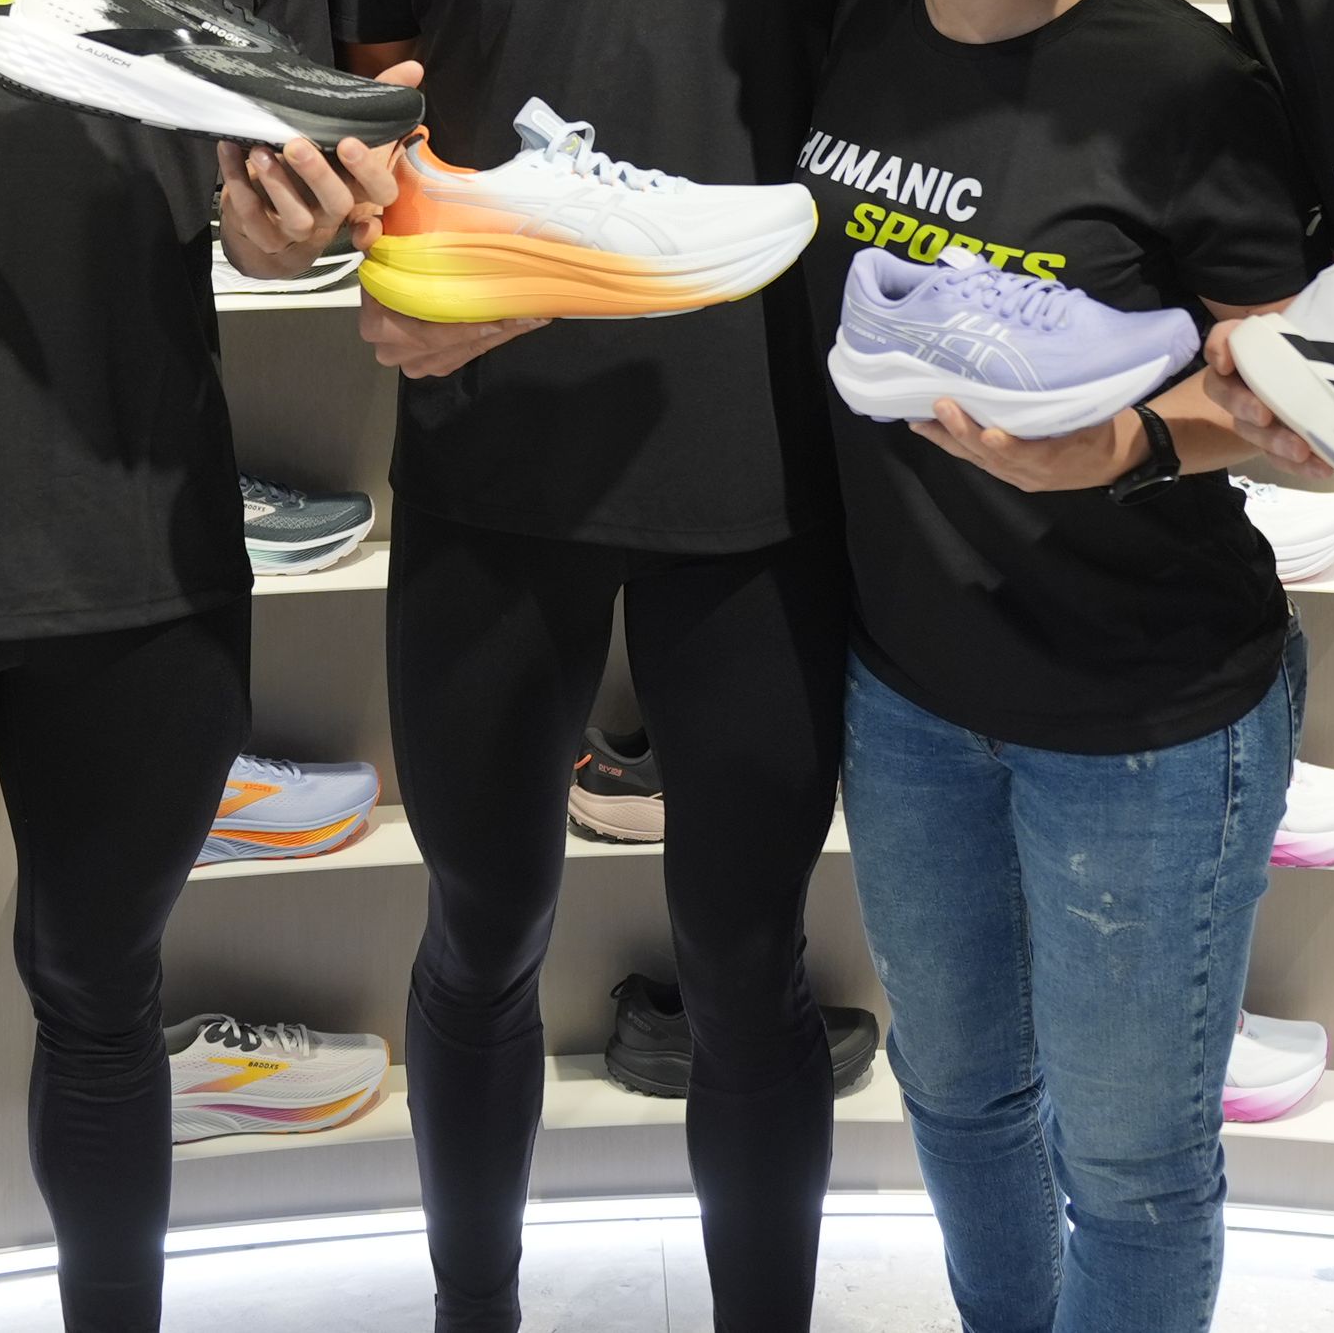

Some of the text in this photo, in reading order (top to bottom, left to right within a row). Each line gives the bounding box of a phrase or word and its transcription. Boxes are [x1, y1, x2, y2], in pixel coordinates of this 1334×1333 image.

[201, 21, 251, 48] BROOKS
[76, 43, 131, 68] LAUNCH
[248, 1061, 279, 1070] BROOKS
